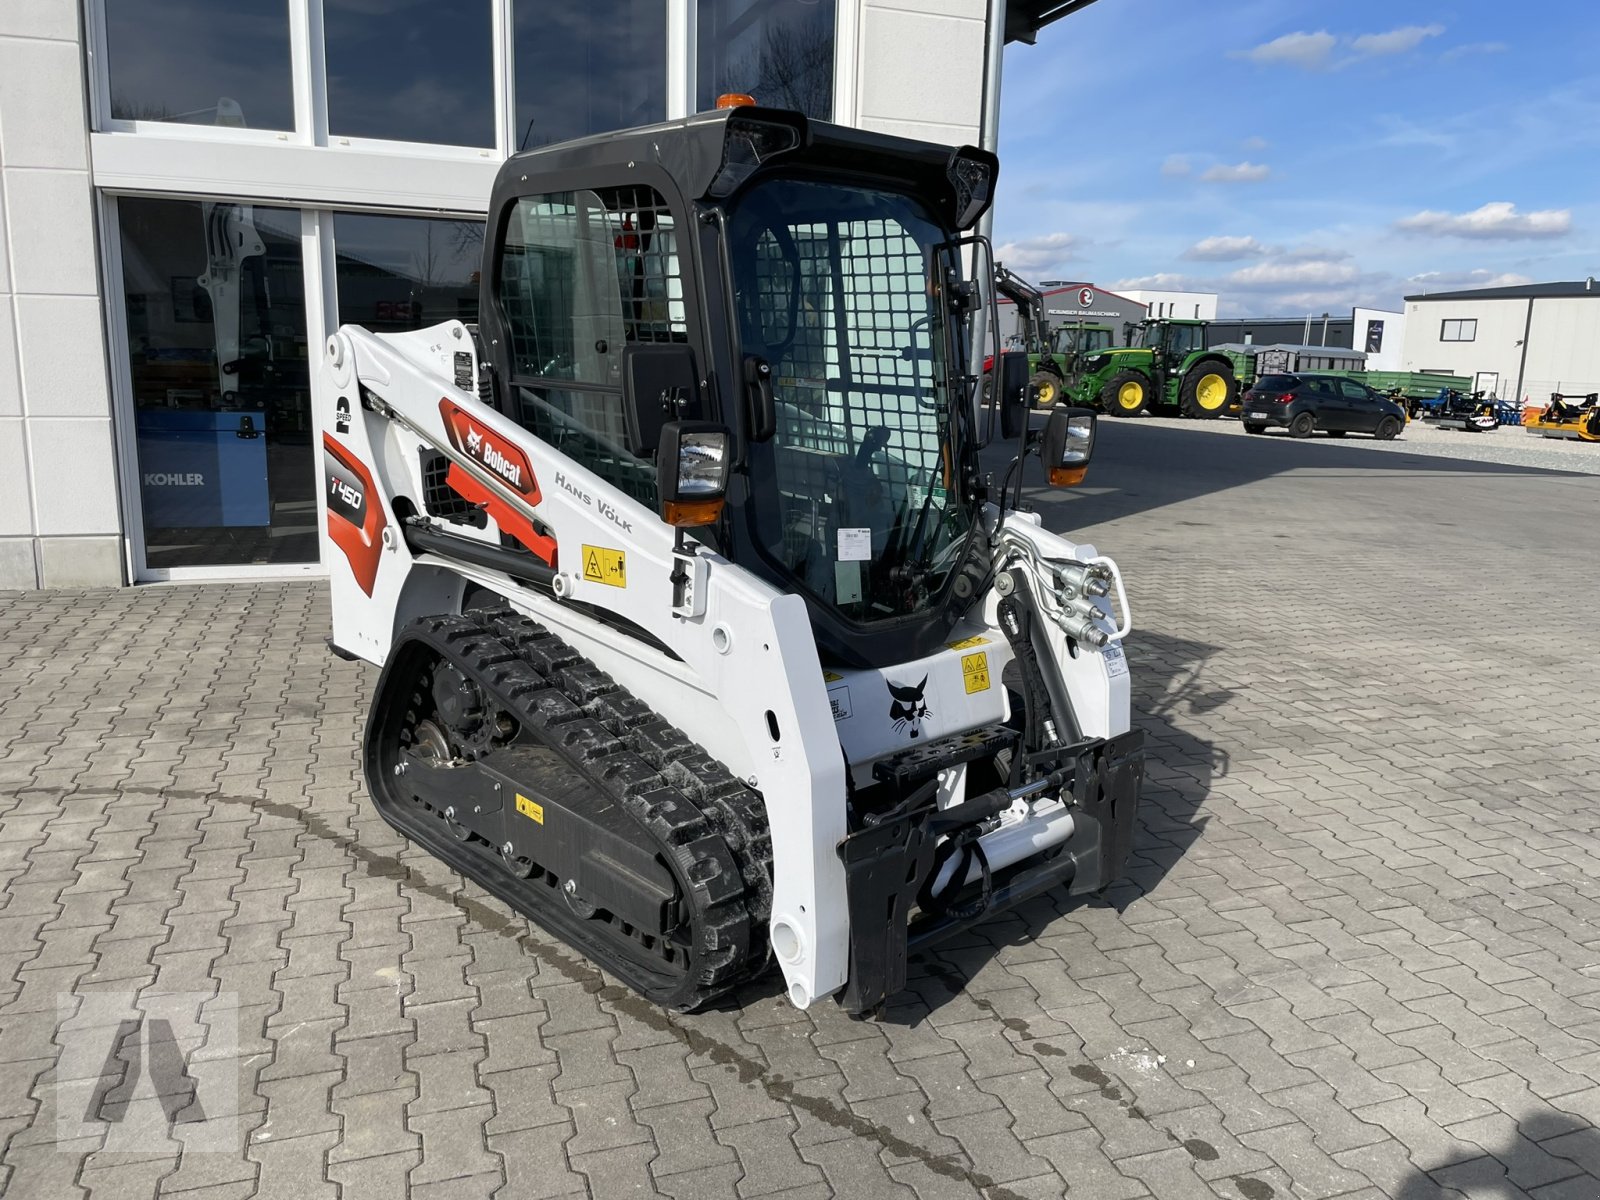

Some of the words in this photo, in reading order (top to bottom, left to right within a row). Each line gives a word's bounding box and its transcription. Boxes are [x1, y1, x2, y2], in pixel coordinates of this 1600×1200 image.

[336, 412, 352, 422] SPEED
[145, 473, 205, 486] KOHLER
[483, 442, 520, 486] Bobcat
[331, 477, 362, 510] T450
[554, 471, 592, 506] HANS
[597, 498, 633, 534] VÖLK
